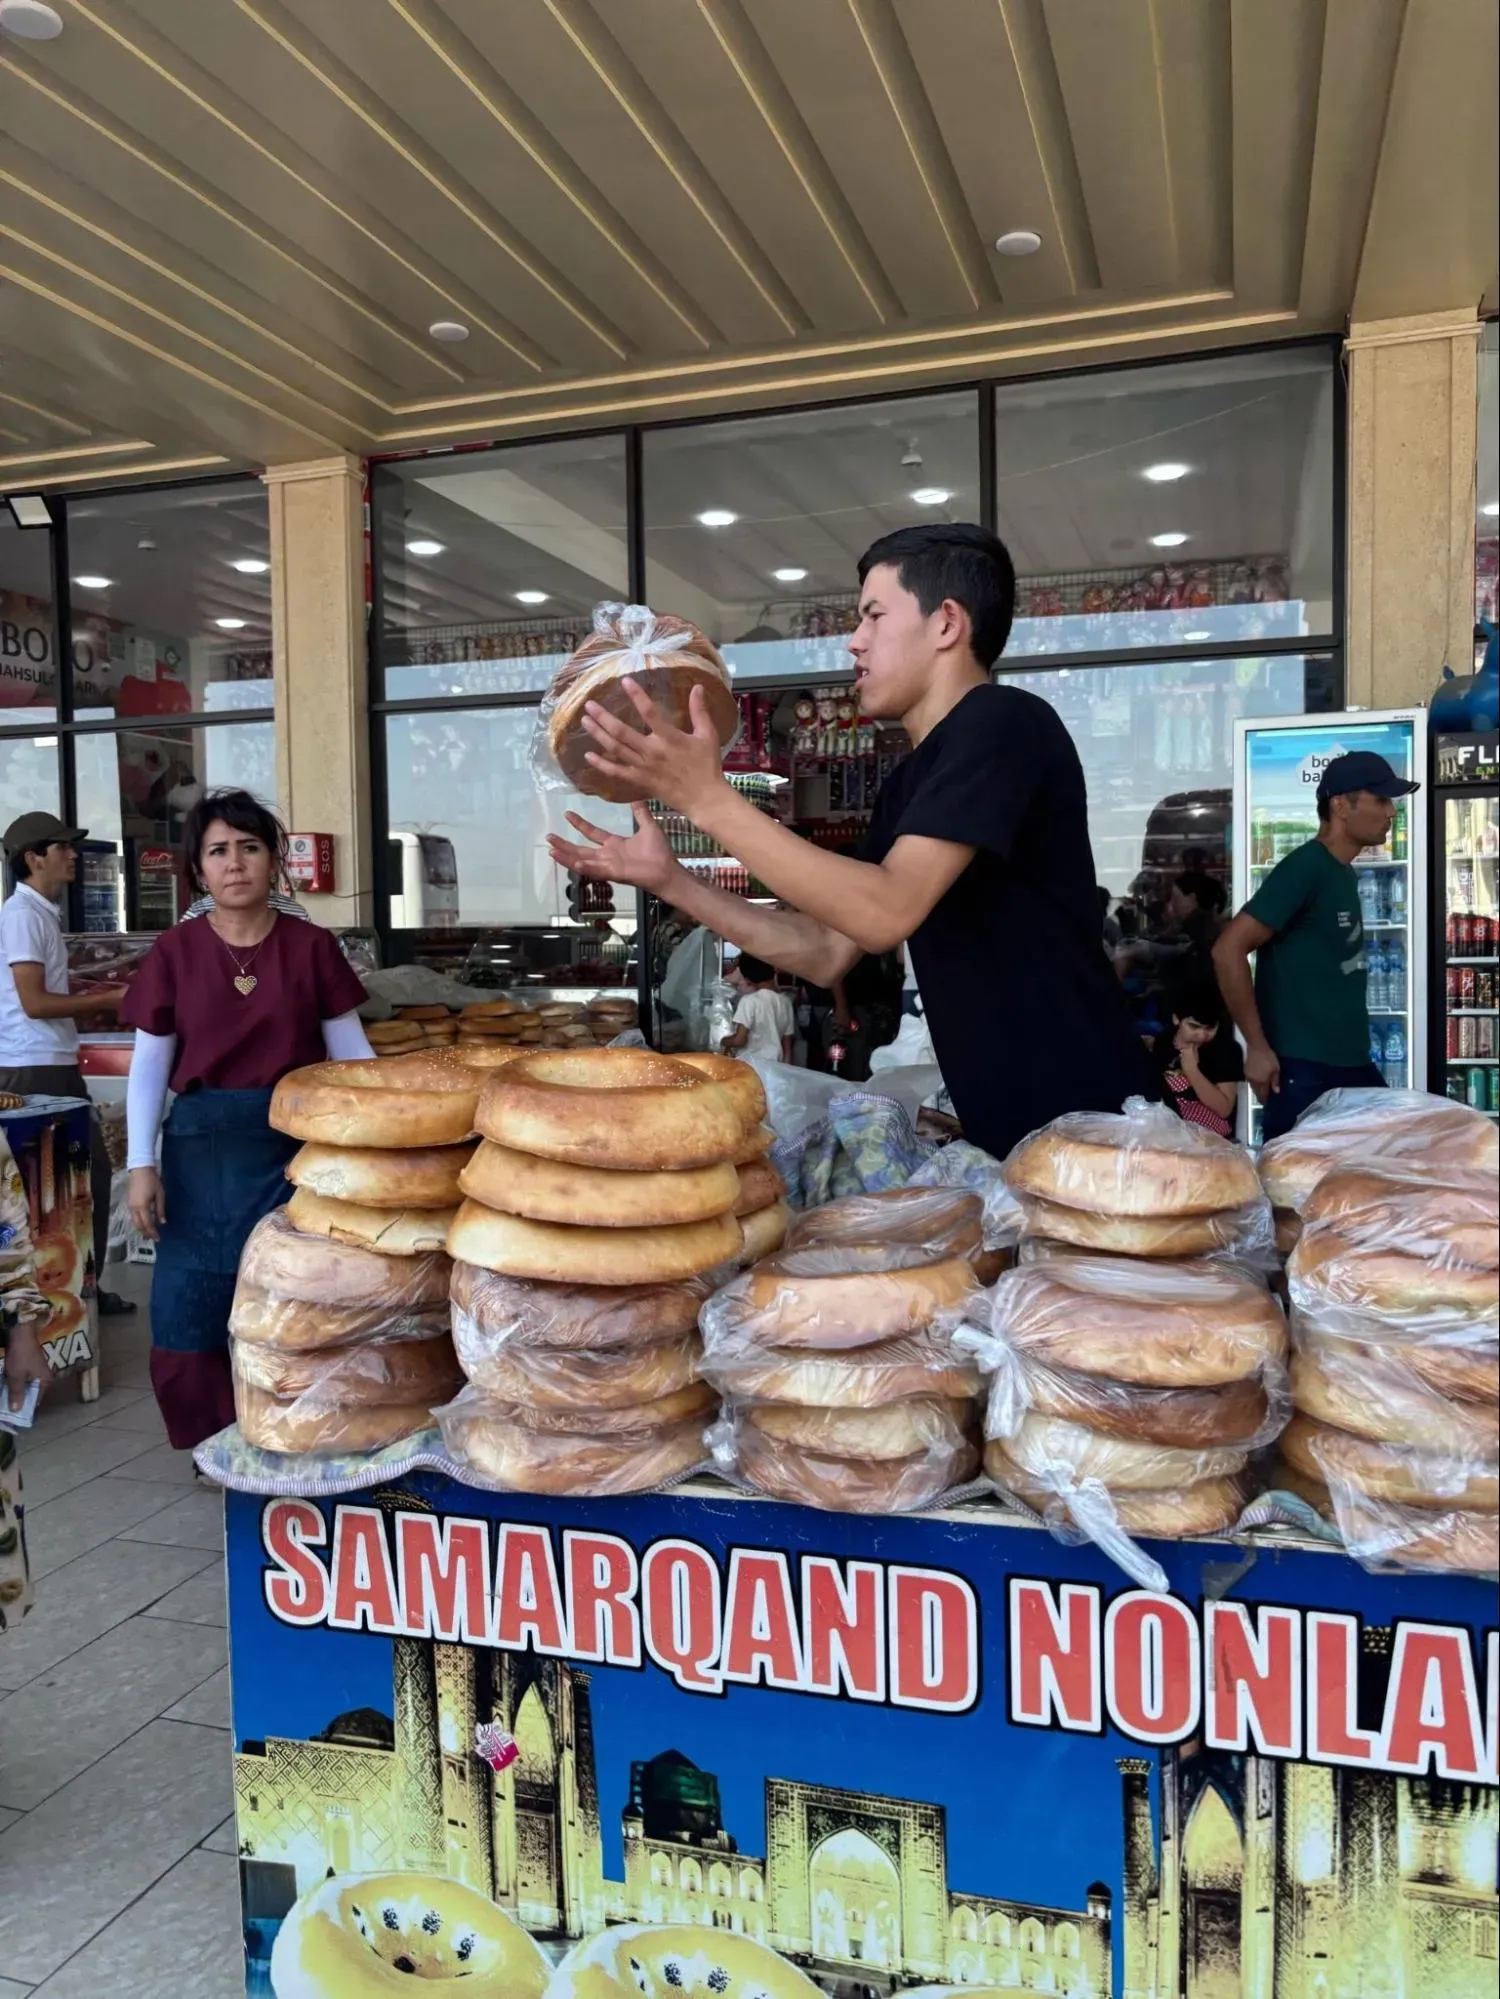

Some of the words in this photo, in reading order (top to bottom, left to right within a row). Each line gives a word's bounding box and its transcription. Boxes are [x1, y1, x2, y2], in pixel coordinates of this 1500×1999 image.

[1, 621, 93, 673] BOO
[320, 840, 330, 873] SOS
[41, 1330, 93, 1370] XA
[263, 1496, 979, 1713] SAMARQAND
[1009, 1577, 1499, 1786] NONLA
